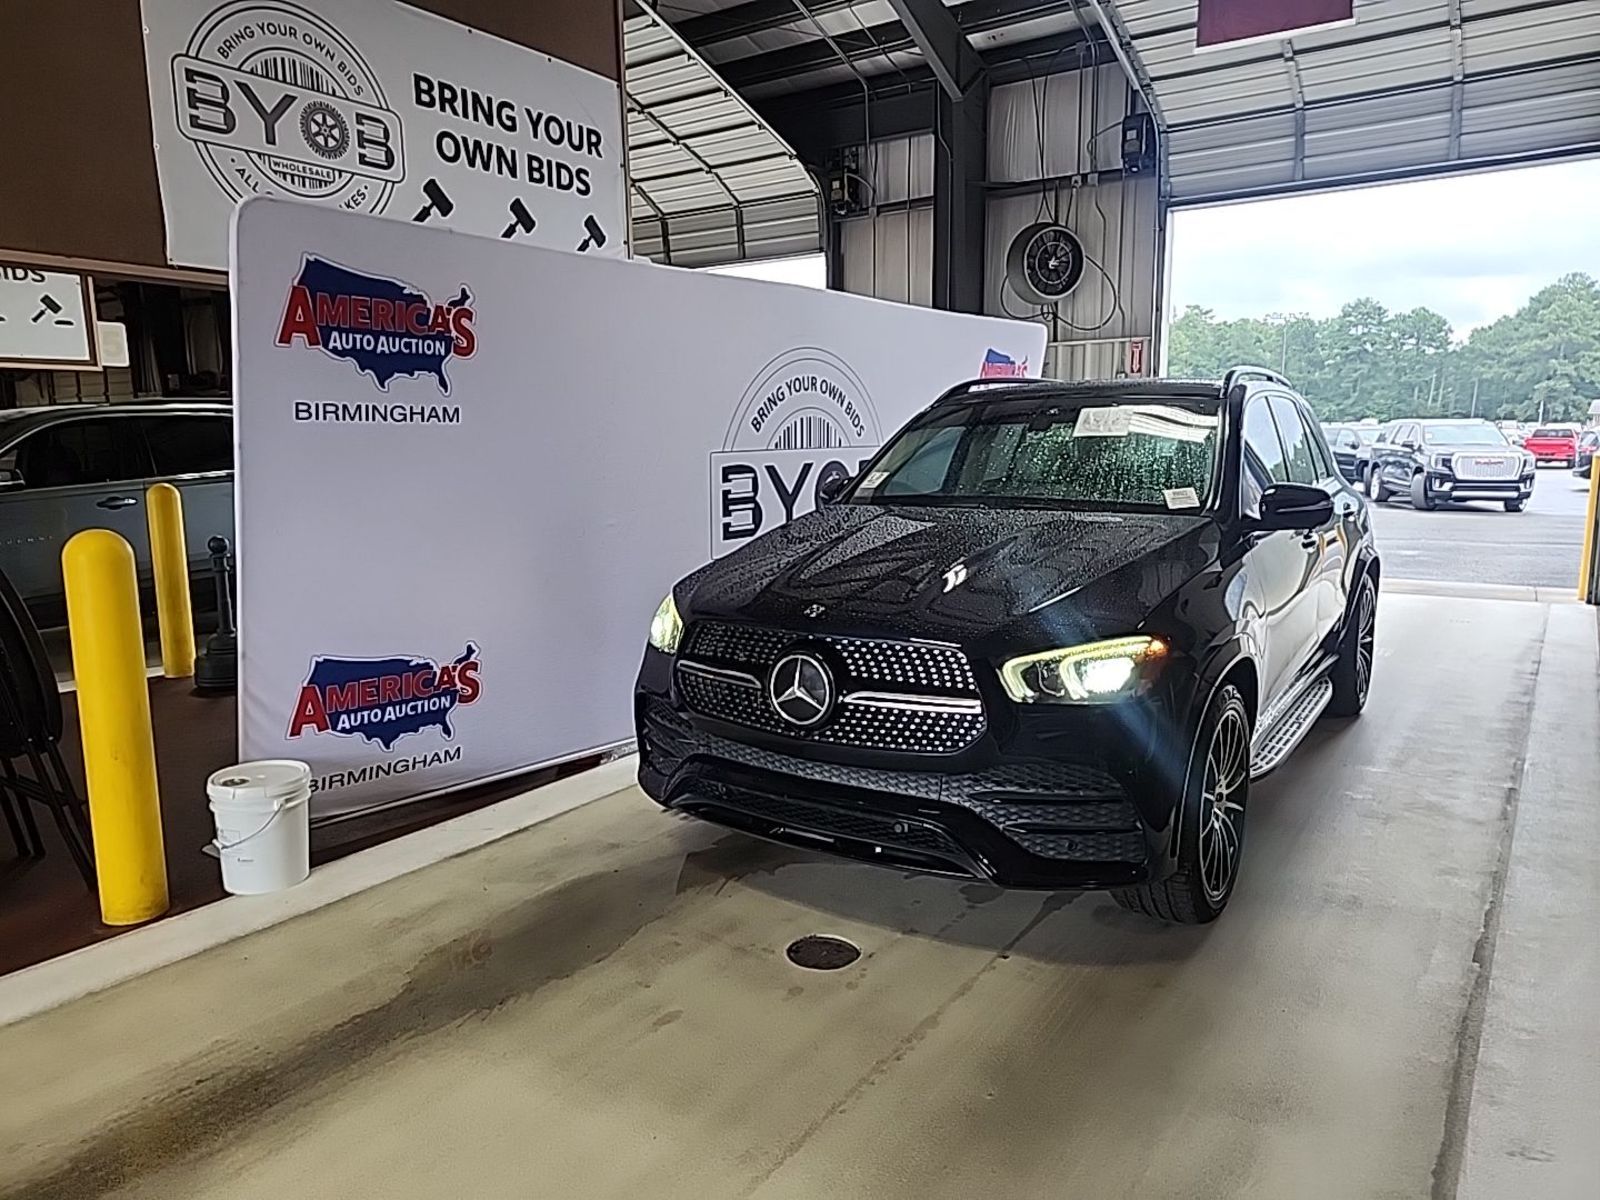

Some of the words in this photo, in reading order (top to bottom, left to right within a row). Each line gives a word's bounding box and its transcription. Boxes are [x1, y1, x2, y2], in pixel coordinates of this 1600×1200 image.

[217, 26, 255, 59] BRING
[256, 22, 298, 39] YOUR
[302, 33, 336, 62] OWN
[338, 61, 364, 96] BIDS
[413, 73, 518, 132] BRING
[524, 108, 603, 159] YOUR
[235, 167, 259, 194] ALL
[272, 159, 332, 179] WHOLESALE
[436, 130, 518, 179] OWN
[527, 153, 591, 196] BIDS
[0, 265, 45, 282] IDS
[277, 285, 476, 358] AMERICA'S
[329, 331, 375, 351] AUTO
[376, 335, 445, 356] AUCTION
[295, 402, 460, 423] BIRMINGHAM
[751, 386, 785, 433] BRING
[786, 375, 817, 396] YOUR
[820, 379, 846, 408] OWN
[845, 401, 865, 437] BIDS
[289, 661, 480, 738] AMERICA'S
[337, 708, 382, 731] AUTO
[383, 695, 451, 723] AUCTION
